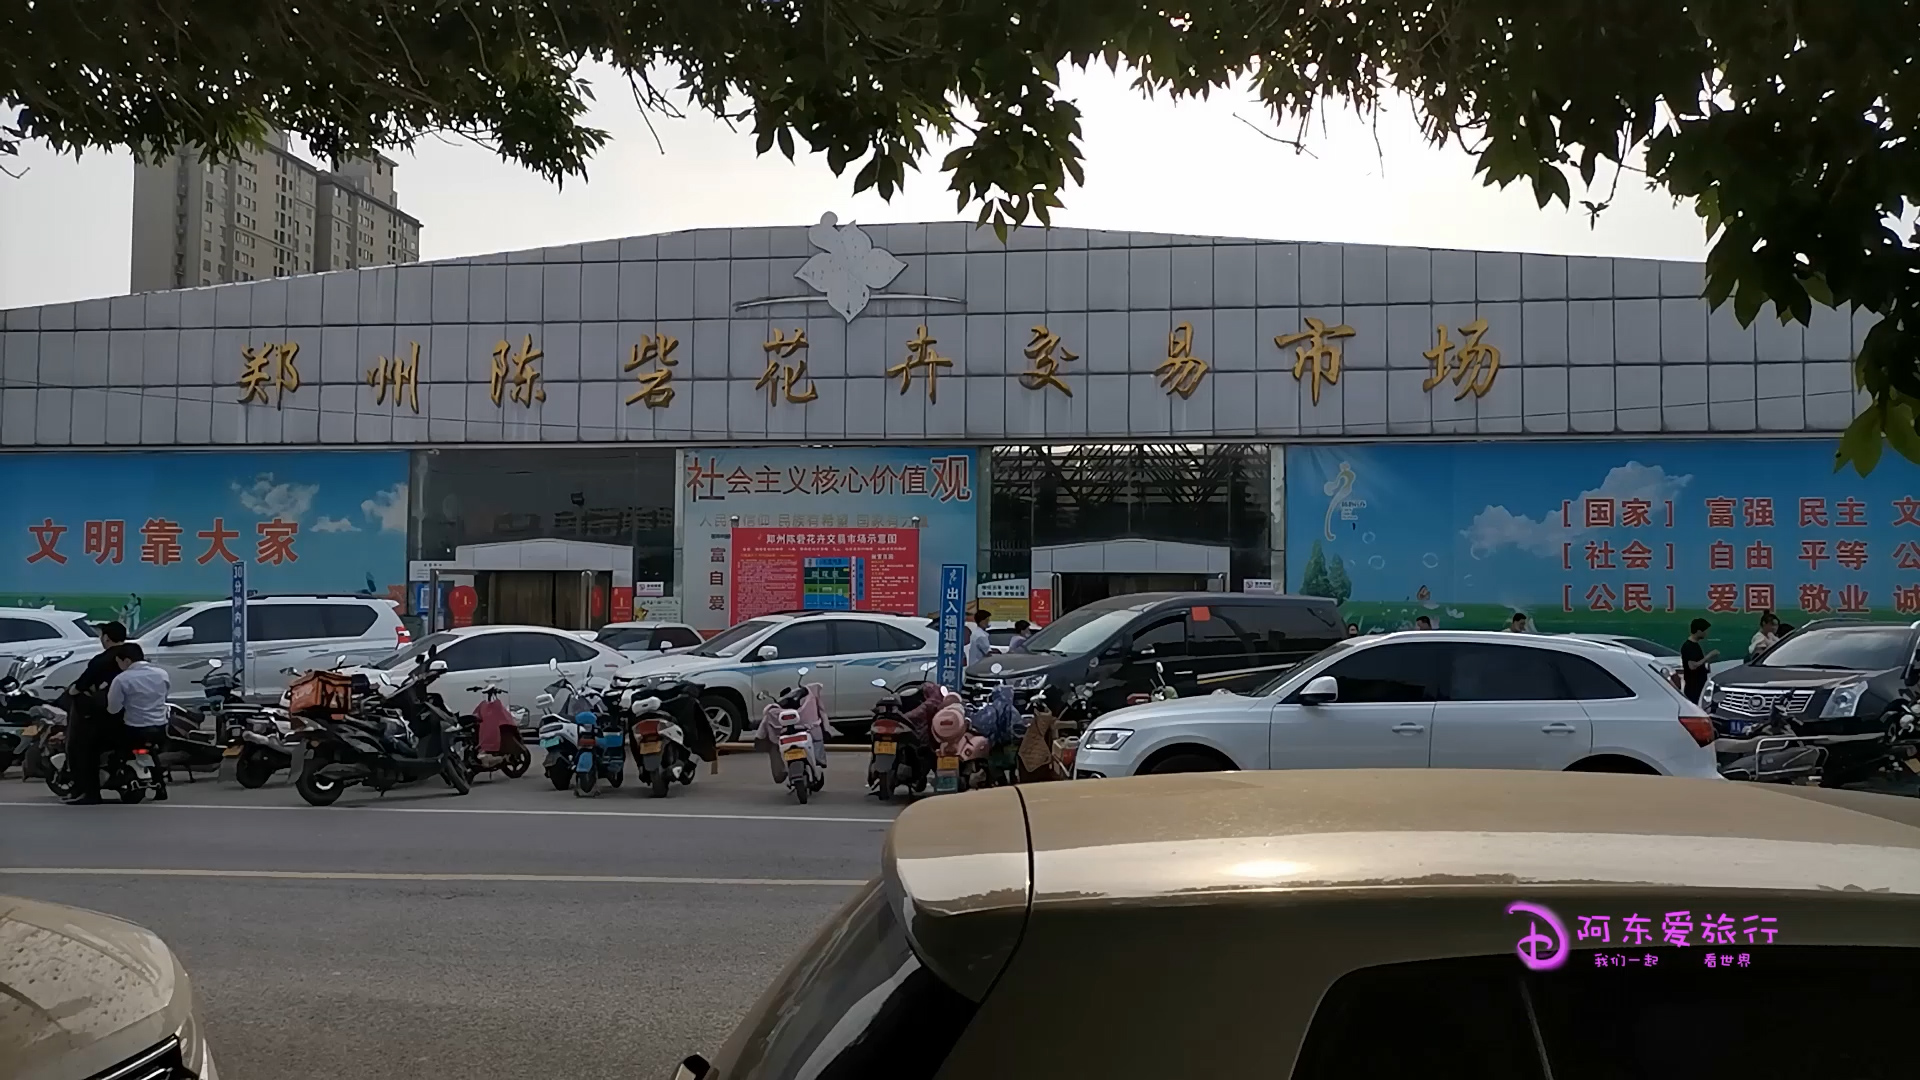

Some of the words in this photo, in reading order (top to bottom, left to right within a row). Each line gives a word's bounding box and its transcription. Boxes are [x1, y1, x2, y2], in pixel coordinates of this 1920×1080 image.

[238, 318, 1503, 414] 郑州陈砦花卉交易市场
[685, 455, 972, 503] 社会主义核心价值观
[699, 514, 770, 527] 人民信仰
[1705, 497, 1775, 528] 富强
[1798, 497, 1869, 528] 民主
[26, 518, 299, 566] 文明靠大家
[1710, 540, 1774, 570] 自由
[1798, 540, 1869, 570] 平等
[1037, 600, 1045, 610] 2
[1707, 583, 1775, 613] 爱国
[1798, 583, 1870, 613] 敬业
